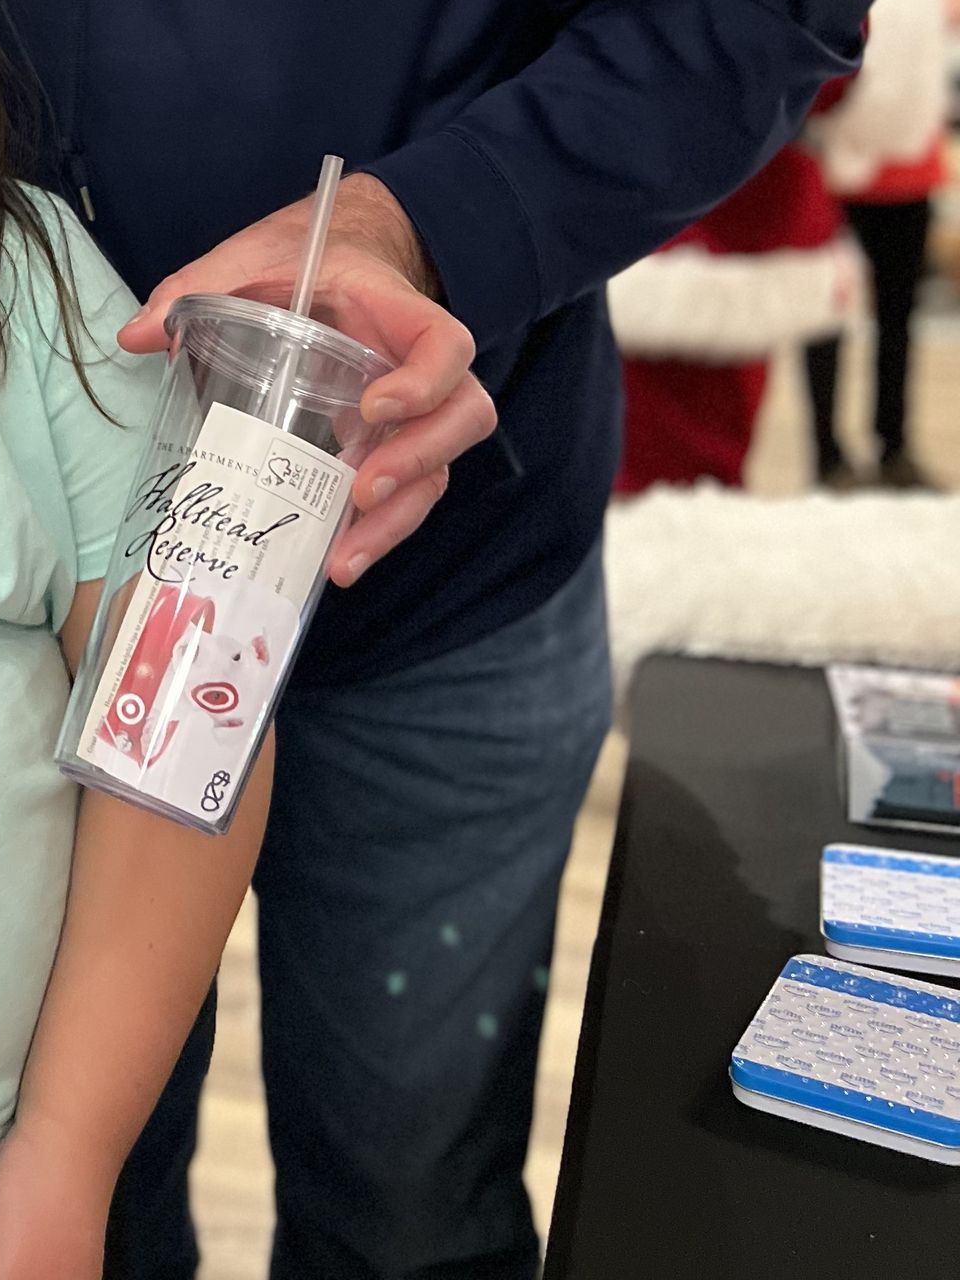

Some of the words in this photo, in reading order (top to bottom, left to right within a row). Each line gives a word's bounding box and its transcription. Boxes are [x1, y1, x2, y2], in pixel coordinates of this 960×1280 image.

[157, 442, 174, 453] THE
[177, 446, 259, 477] APARTMENTS
[289, 464, 303, 487] FSC
[200, 769, 231, 812] $20
